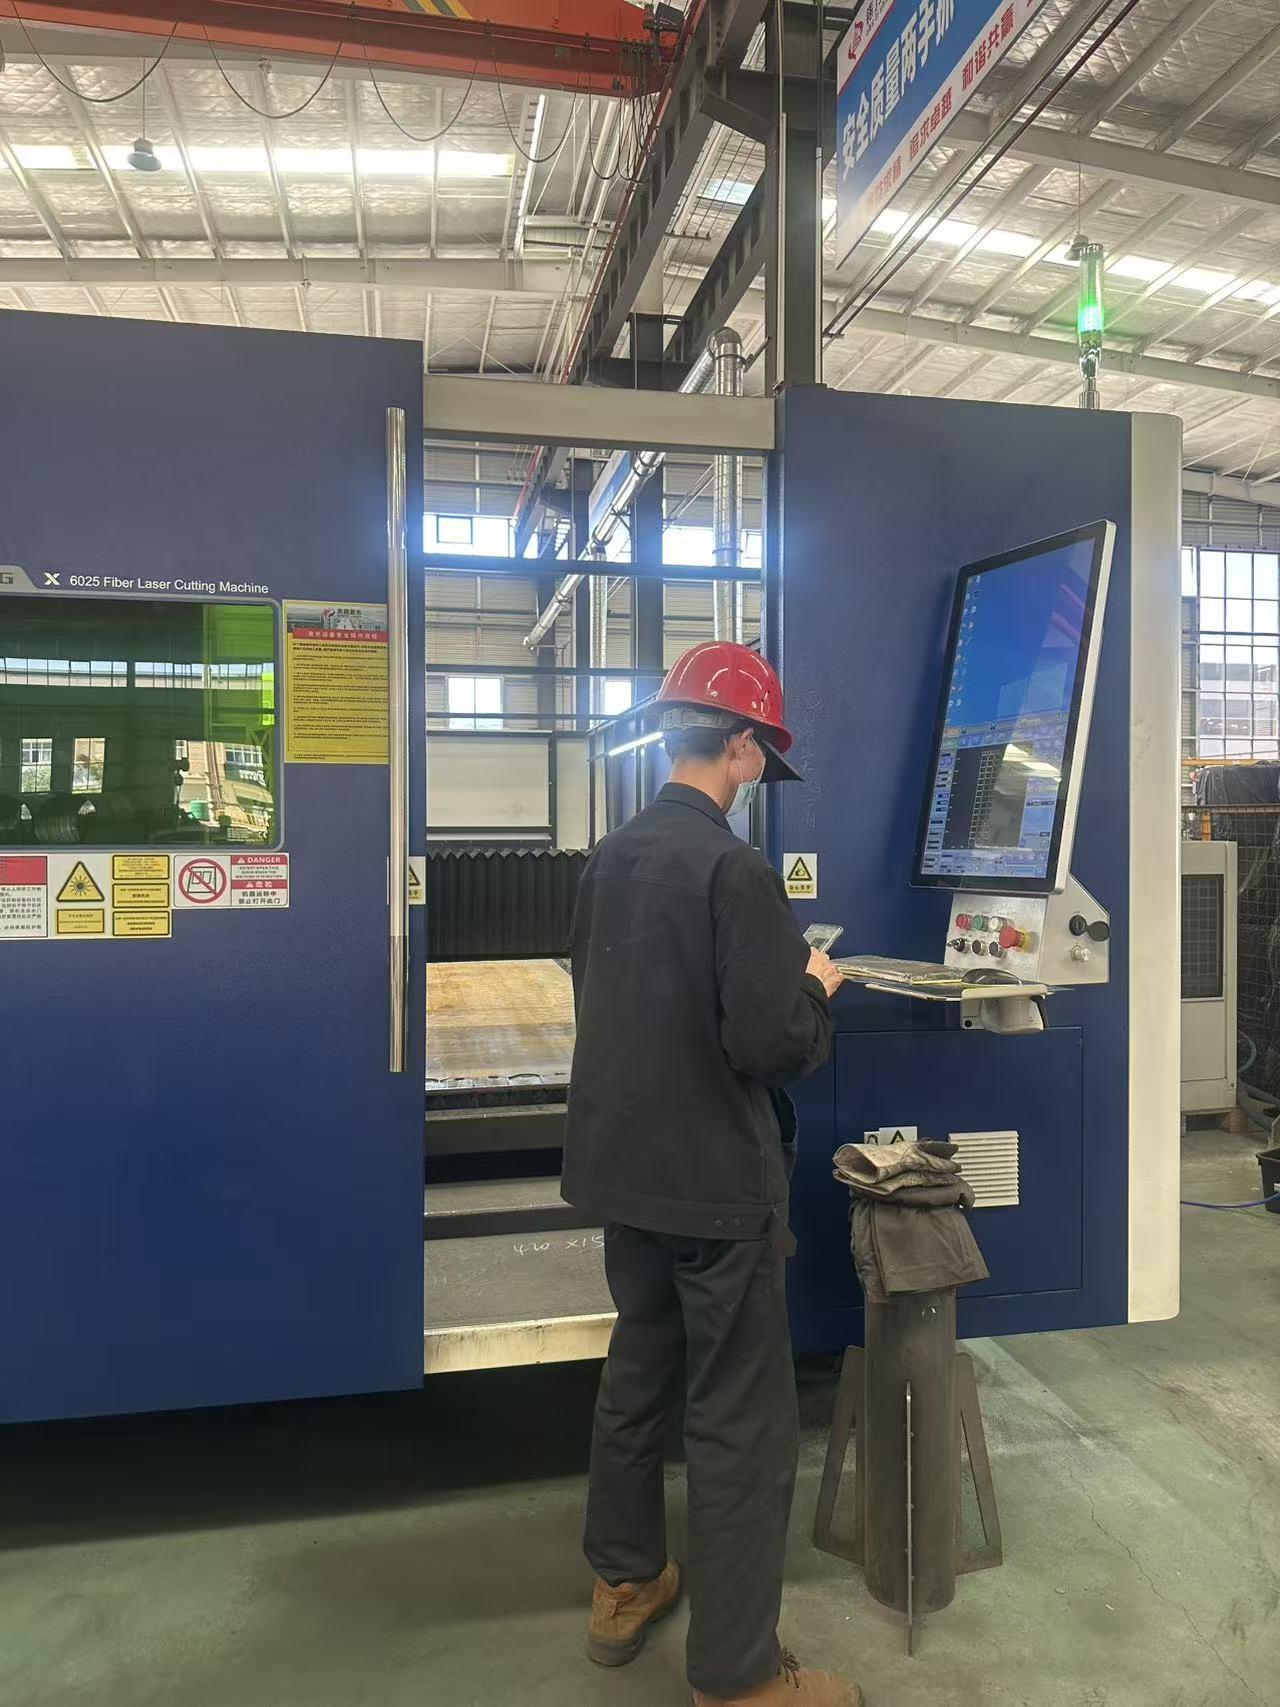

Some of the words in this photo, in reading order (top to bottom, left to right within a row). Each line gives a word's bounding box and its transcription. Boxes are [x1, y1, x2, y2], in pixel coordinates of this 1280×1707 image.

[909, 86, 953, 161] 追求卓越
[962, 3, 1014, 91] 和谐共赢
[69, 575, 101, 587] 6025
[103, 576, 135, 589] Fiber
[137, 578, 172, 590] Laser
[174, 579, 216, 594] Cutting
[219, 581, 269, 594] Machine
[247, 856, 281, 864] DANGER
[255, 880, 272, 888] 危险
[513, 1241, 550, 1256] 420
